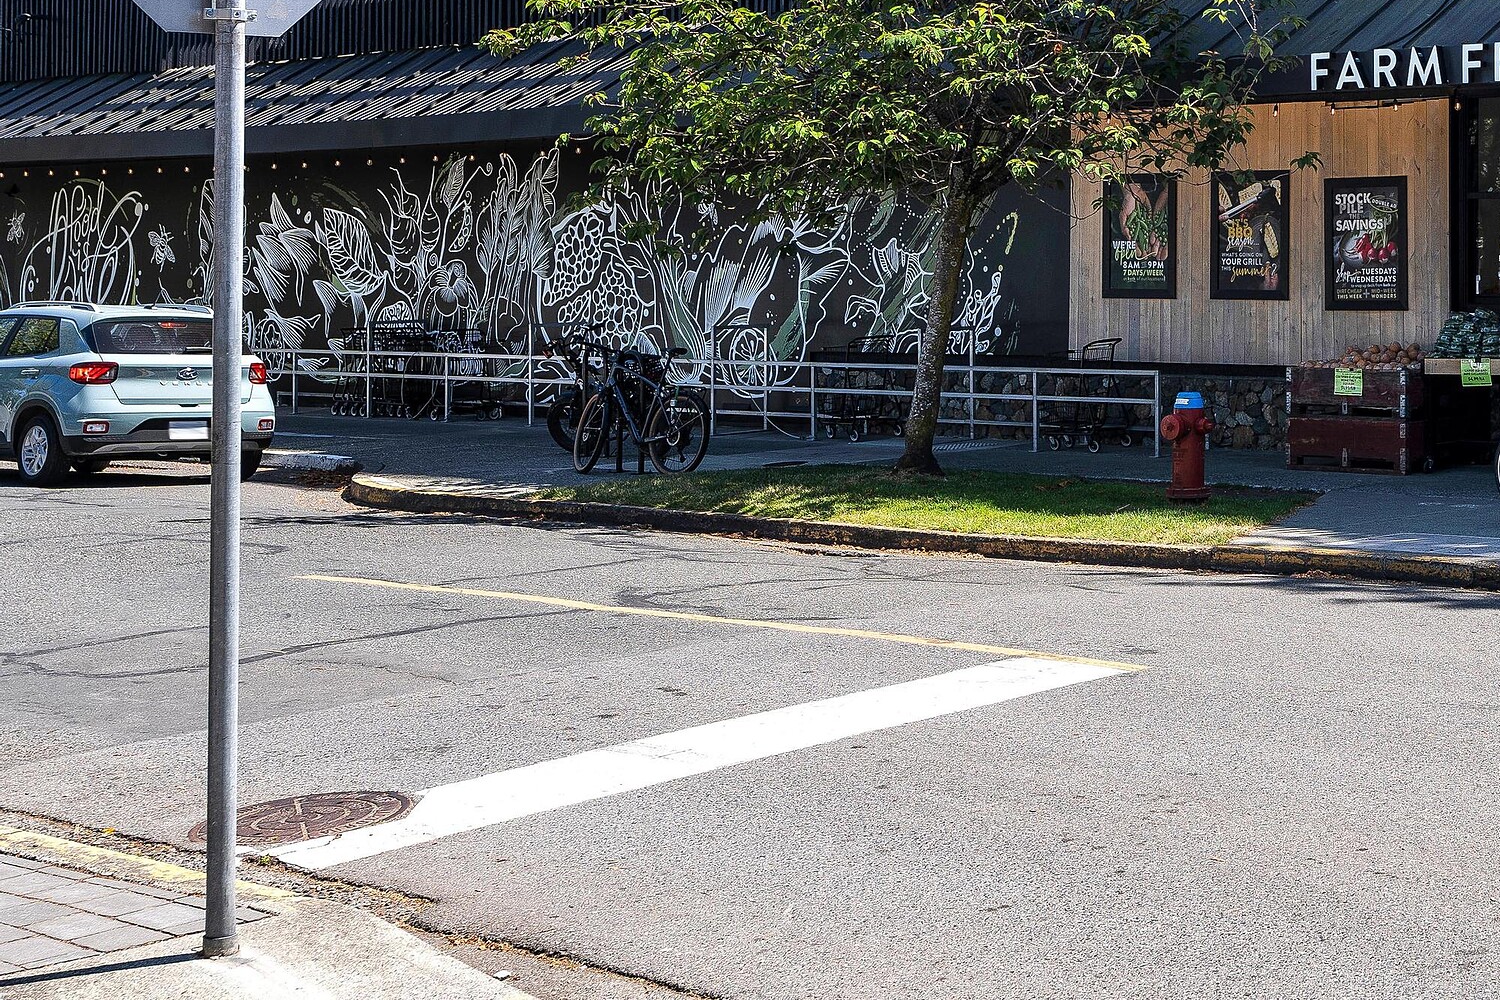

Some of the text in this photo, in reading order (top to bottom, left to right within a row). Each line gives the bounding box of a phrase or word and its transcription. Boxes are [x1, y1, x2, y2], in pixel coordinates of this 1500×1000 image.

[1310, 44, 1443, 92] FARM
[1335, 192, 1371, 205] STOCK
[1339, 203, 1364, 214] PILE
[1231, 219, 1249, 228] IT'S
[1228, 227, 1253, 238] BBQ
[1112, 240, 1137, 250] WE'RE
[1122, 261, 1141, 269] 8AM
[1147, 261, 1164, 269] 9PM
[1221, 257, 1263, 266] YOUR GRILL
[1127, 269, 1164, 277] DAYS/WEEK
[1361, 267, 1397, 275] TUESDAYS
[1350, 275, 1397, 283] WEDNESDAYS
